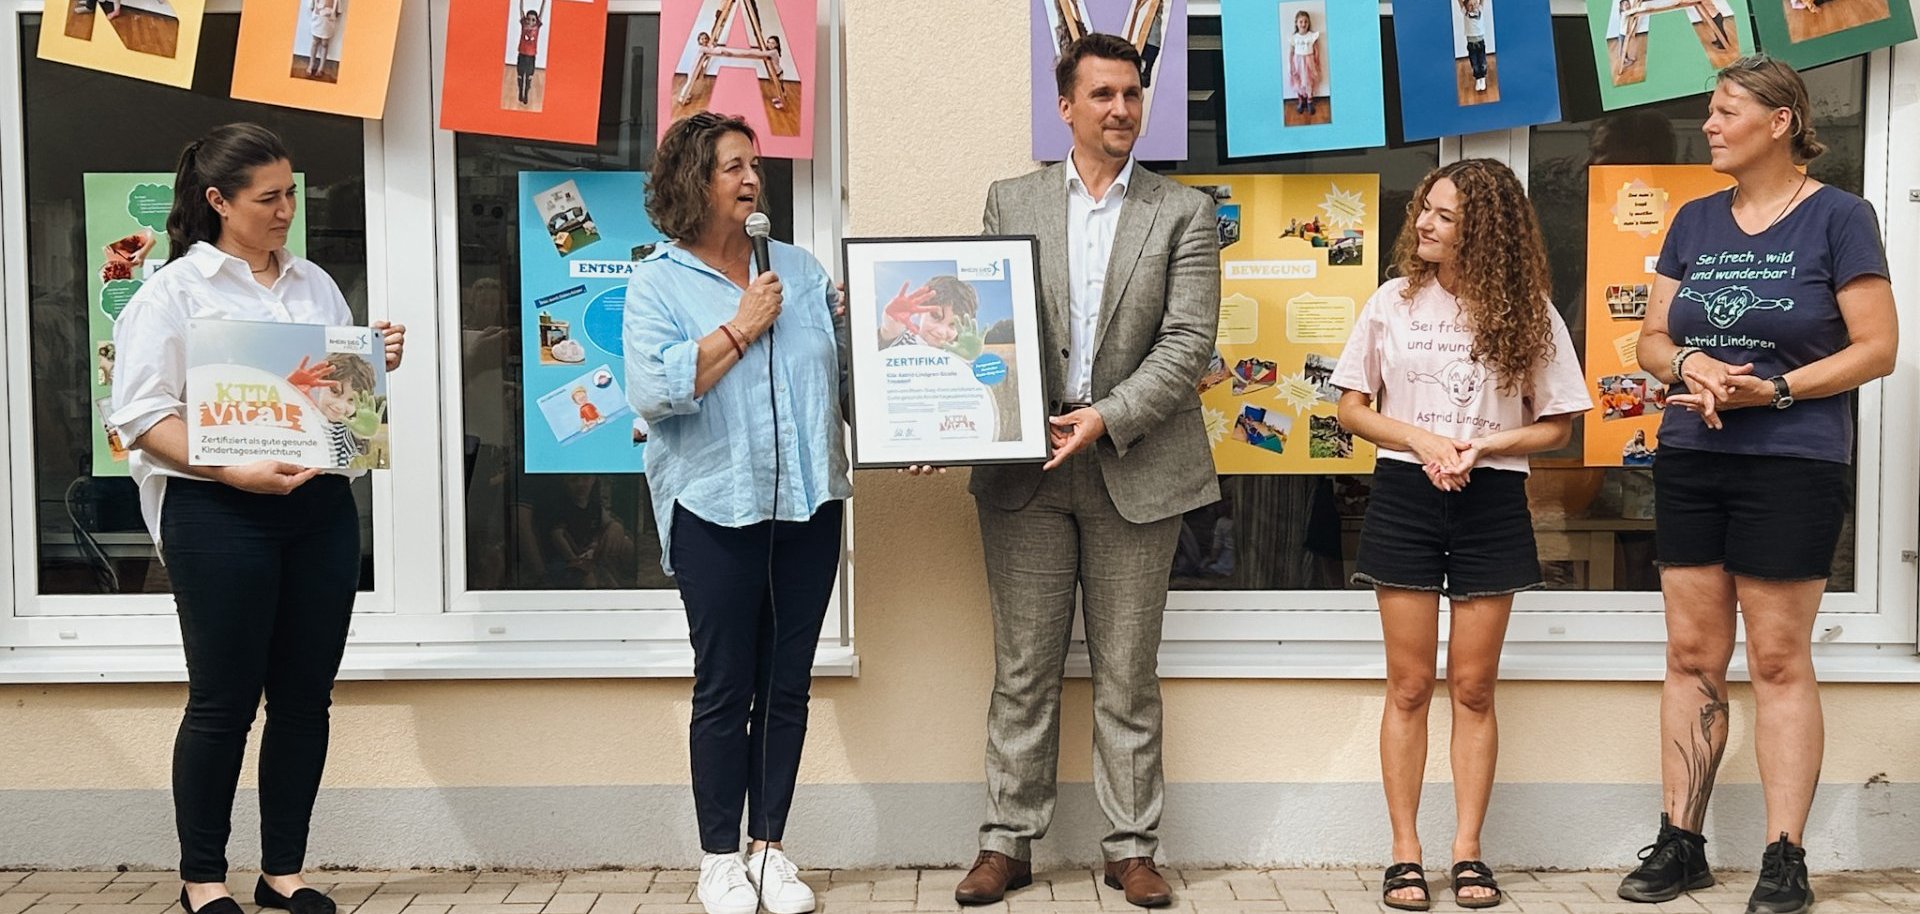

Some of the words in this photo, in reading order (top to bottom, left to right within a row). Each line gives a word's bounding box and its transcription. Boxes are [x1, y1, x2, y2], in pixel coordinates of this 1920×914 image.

[1696, 254, 1718, 266] Sei
[1719, 250, 1755, 265] frech
[1766, 250, 1794, 264] wild
[579, 263, 639, 274] ENTSPA
[1231, 265, 1312, 276] BEWEGUNG
[1690, 268, 1714, 280] und
[1715, 267, 1788, 280] wunderbar
[1410, 321, 1433, 332] Sei
[1438, 320, 1474, 333] frec
[1407, 340, 1433, 351] und
[1720, 334, 1776, 349] Lindgren
[886, 356, 950, 367] ZERTIFIKAT
[216, 383, 282, 403] KITA
[1417, 411, 1453, 423] Astrid
[1456, 412, 1501, 430] Lindgren
[201, 435, 248, 445] Zertifiziert
[249, 437, 260, 445] als
[262, 438, 281, 447] gute
[283, 438, 318, 447] gesunde
[202, 446, 302, 457] Kindertageseinrichtung
